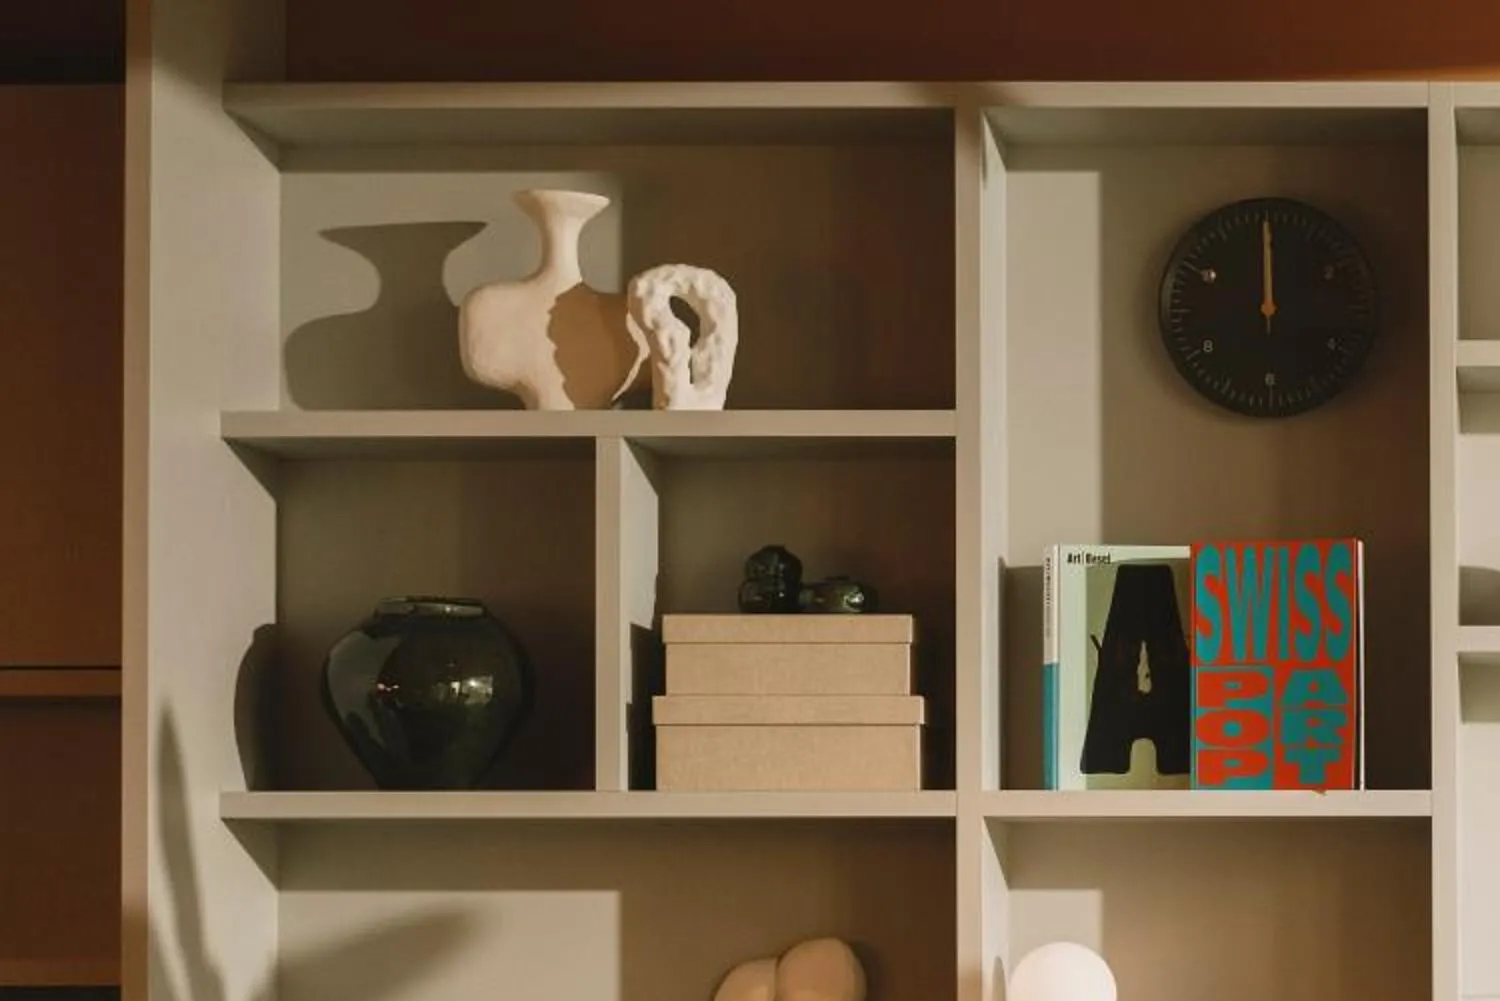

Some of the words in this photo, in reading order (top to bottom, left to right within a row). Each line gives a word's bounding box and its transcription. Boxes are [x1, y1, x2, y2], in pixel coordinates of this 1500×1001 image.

[1196, 543, 1353, 664] SWISS
[1196, 670, 1271, 788] POP
[1280, 668, 1348, 785] ART
